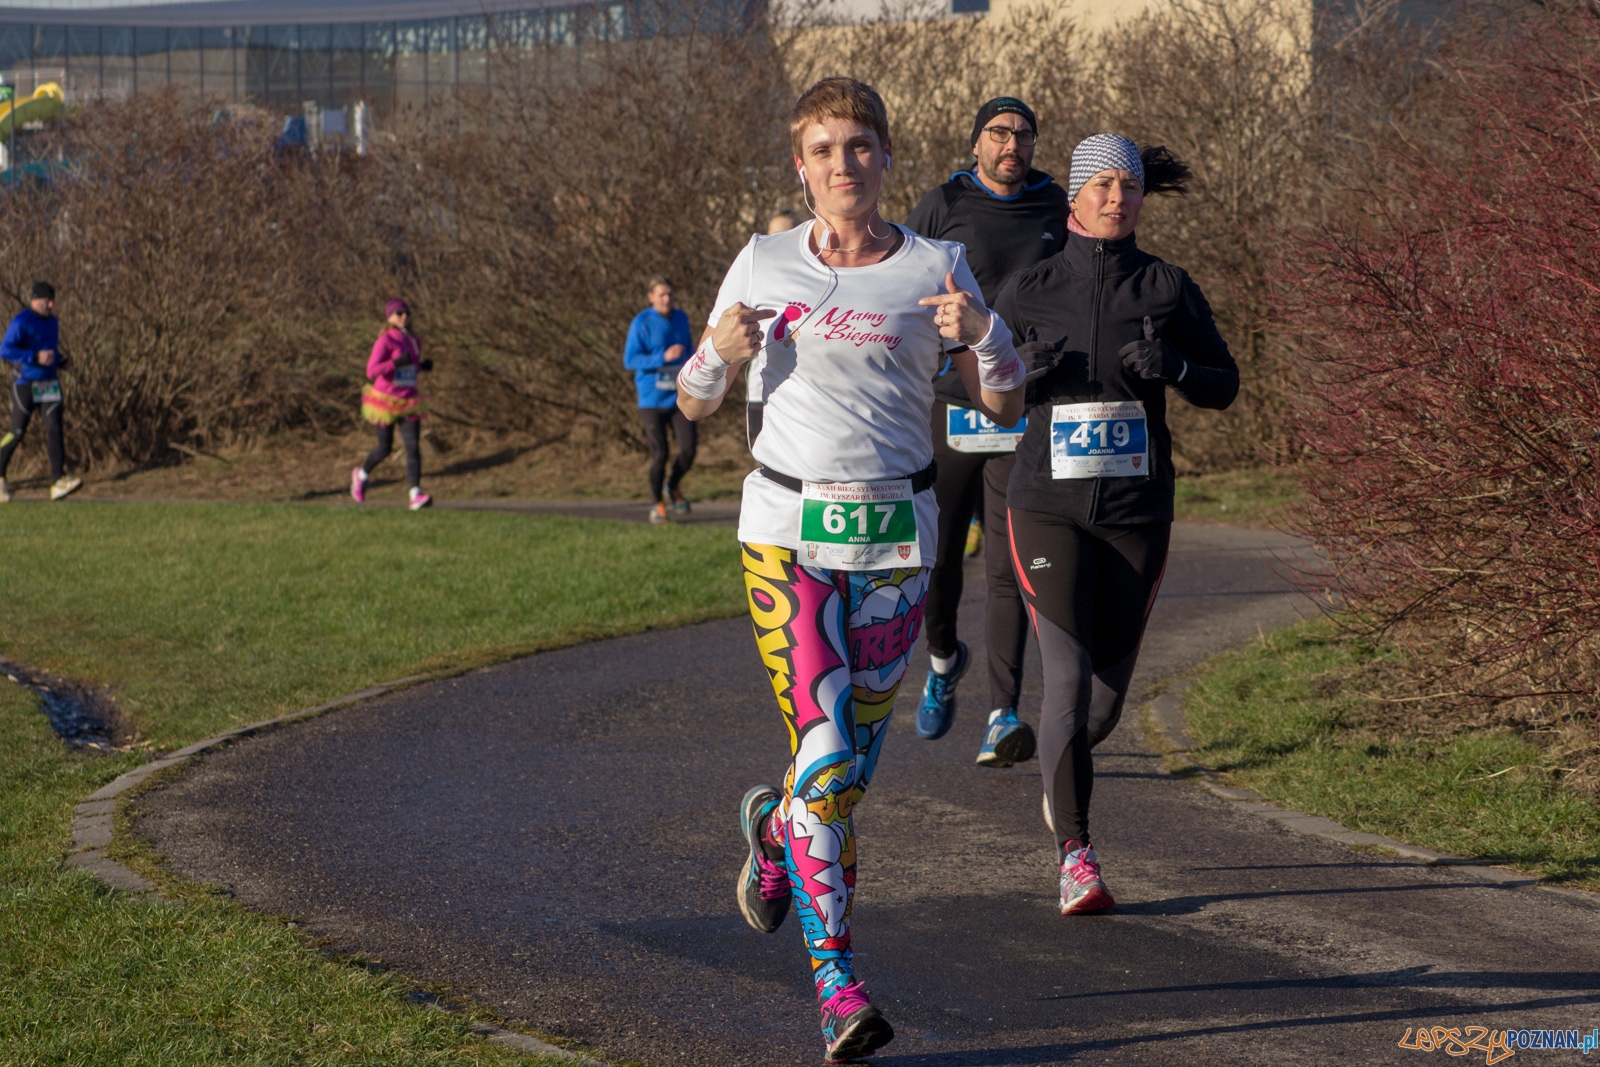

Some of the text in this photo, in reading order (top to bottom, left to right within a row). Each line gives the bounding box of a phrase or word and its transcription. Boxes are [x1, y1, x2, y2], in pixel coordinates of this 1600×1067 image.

[814, 307, 888, 328] Mamy
[823, 323, 903, 351] Biegamy
[1069, 421, 1130, 448] 419
[857, 484, 906, 493] SYLWESTROWY
[872, 492, 904, 500] BURGIELA
[822, 503, 897, 535] 617
